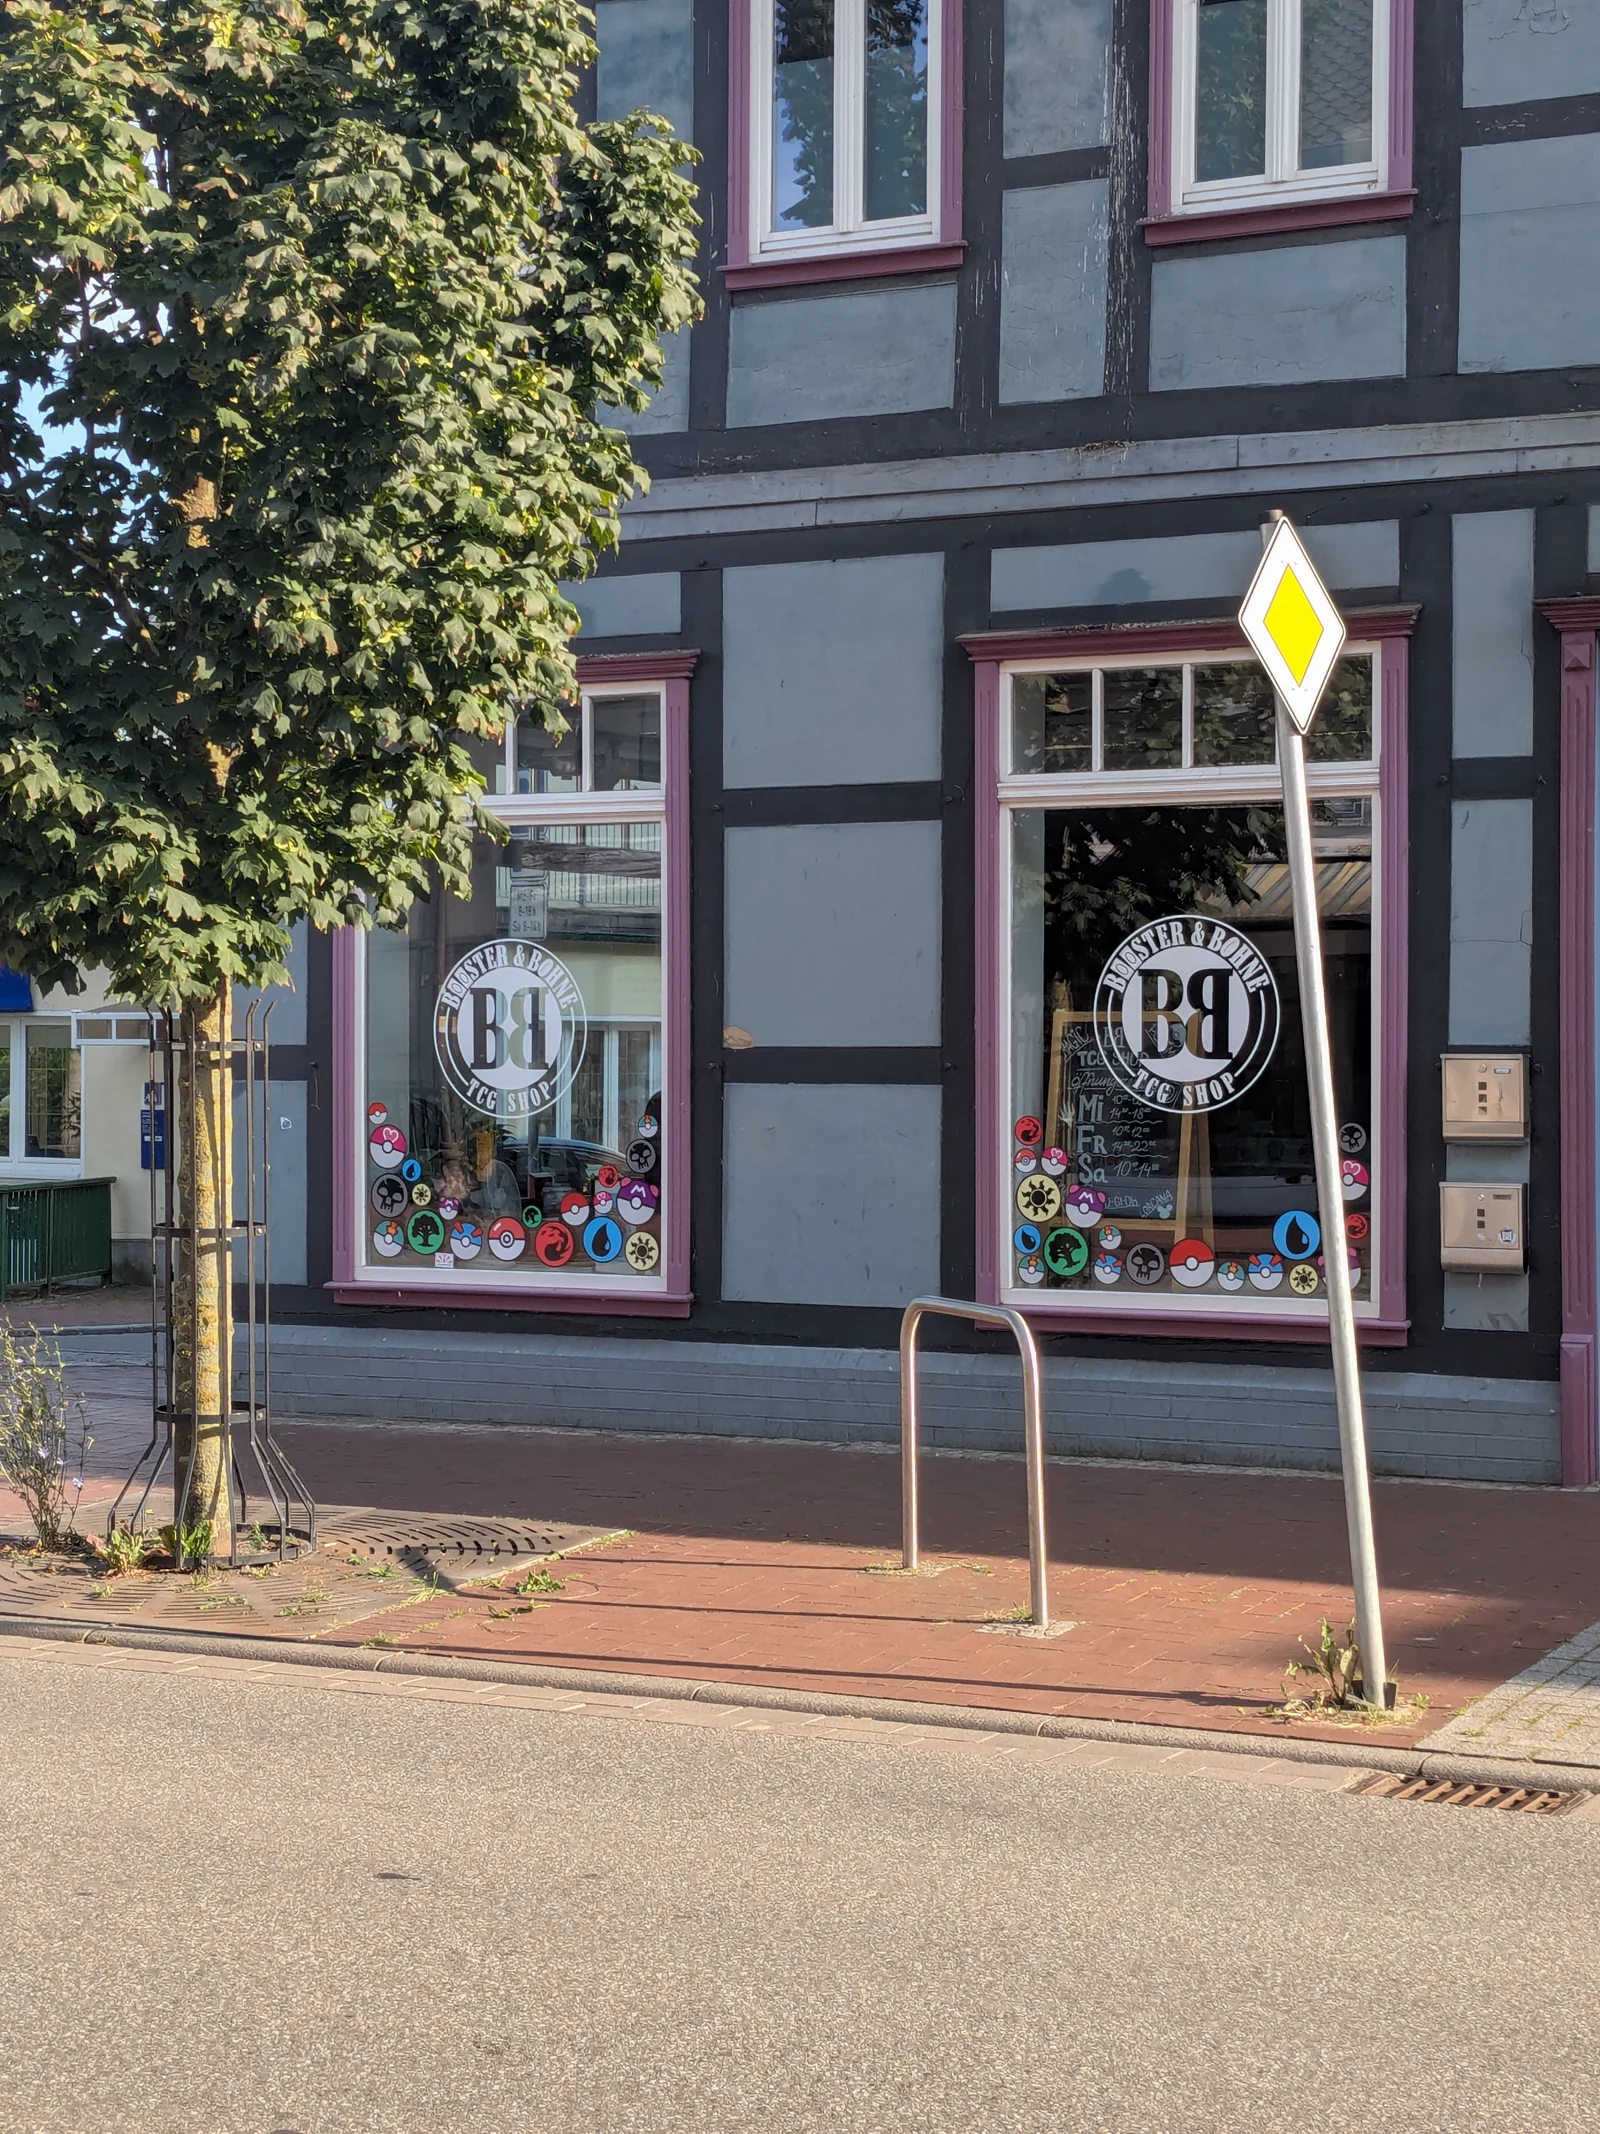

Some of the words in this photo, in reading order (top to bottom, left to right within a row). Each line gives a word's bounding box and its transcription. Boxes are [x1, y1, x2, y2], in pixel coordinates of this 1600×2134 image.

[1103, 921, 1185, 994] BOOSTER
[1190, 921, 1205, 946] &
[1207, 925, 1270, 993] BOHNE
[441, 944, 509, 1010] BOOSTER
[513, 944, 525, 967] &
[527, 948, 579, 1009] BOHNE
[466, 1078, 497, 1111] TCG
[508, 1080, 551, 1112] SHOP
[1132, 1068, 1169, 1103] TCG
[1183, 1072, 1235, 1106] SHOP
[1078, 1094, 1104, 1122] Mi
[1078, 1153, 1108, 1184] Sa
